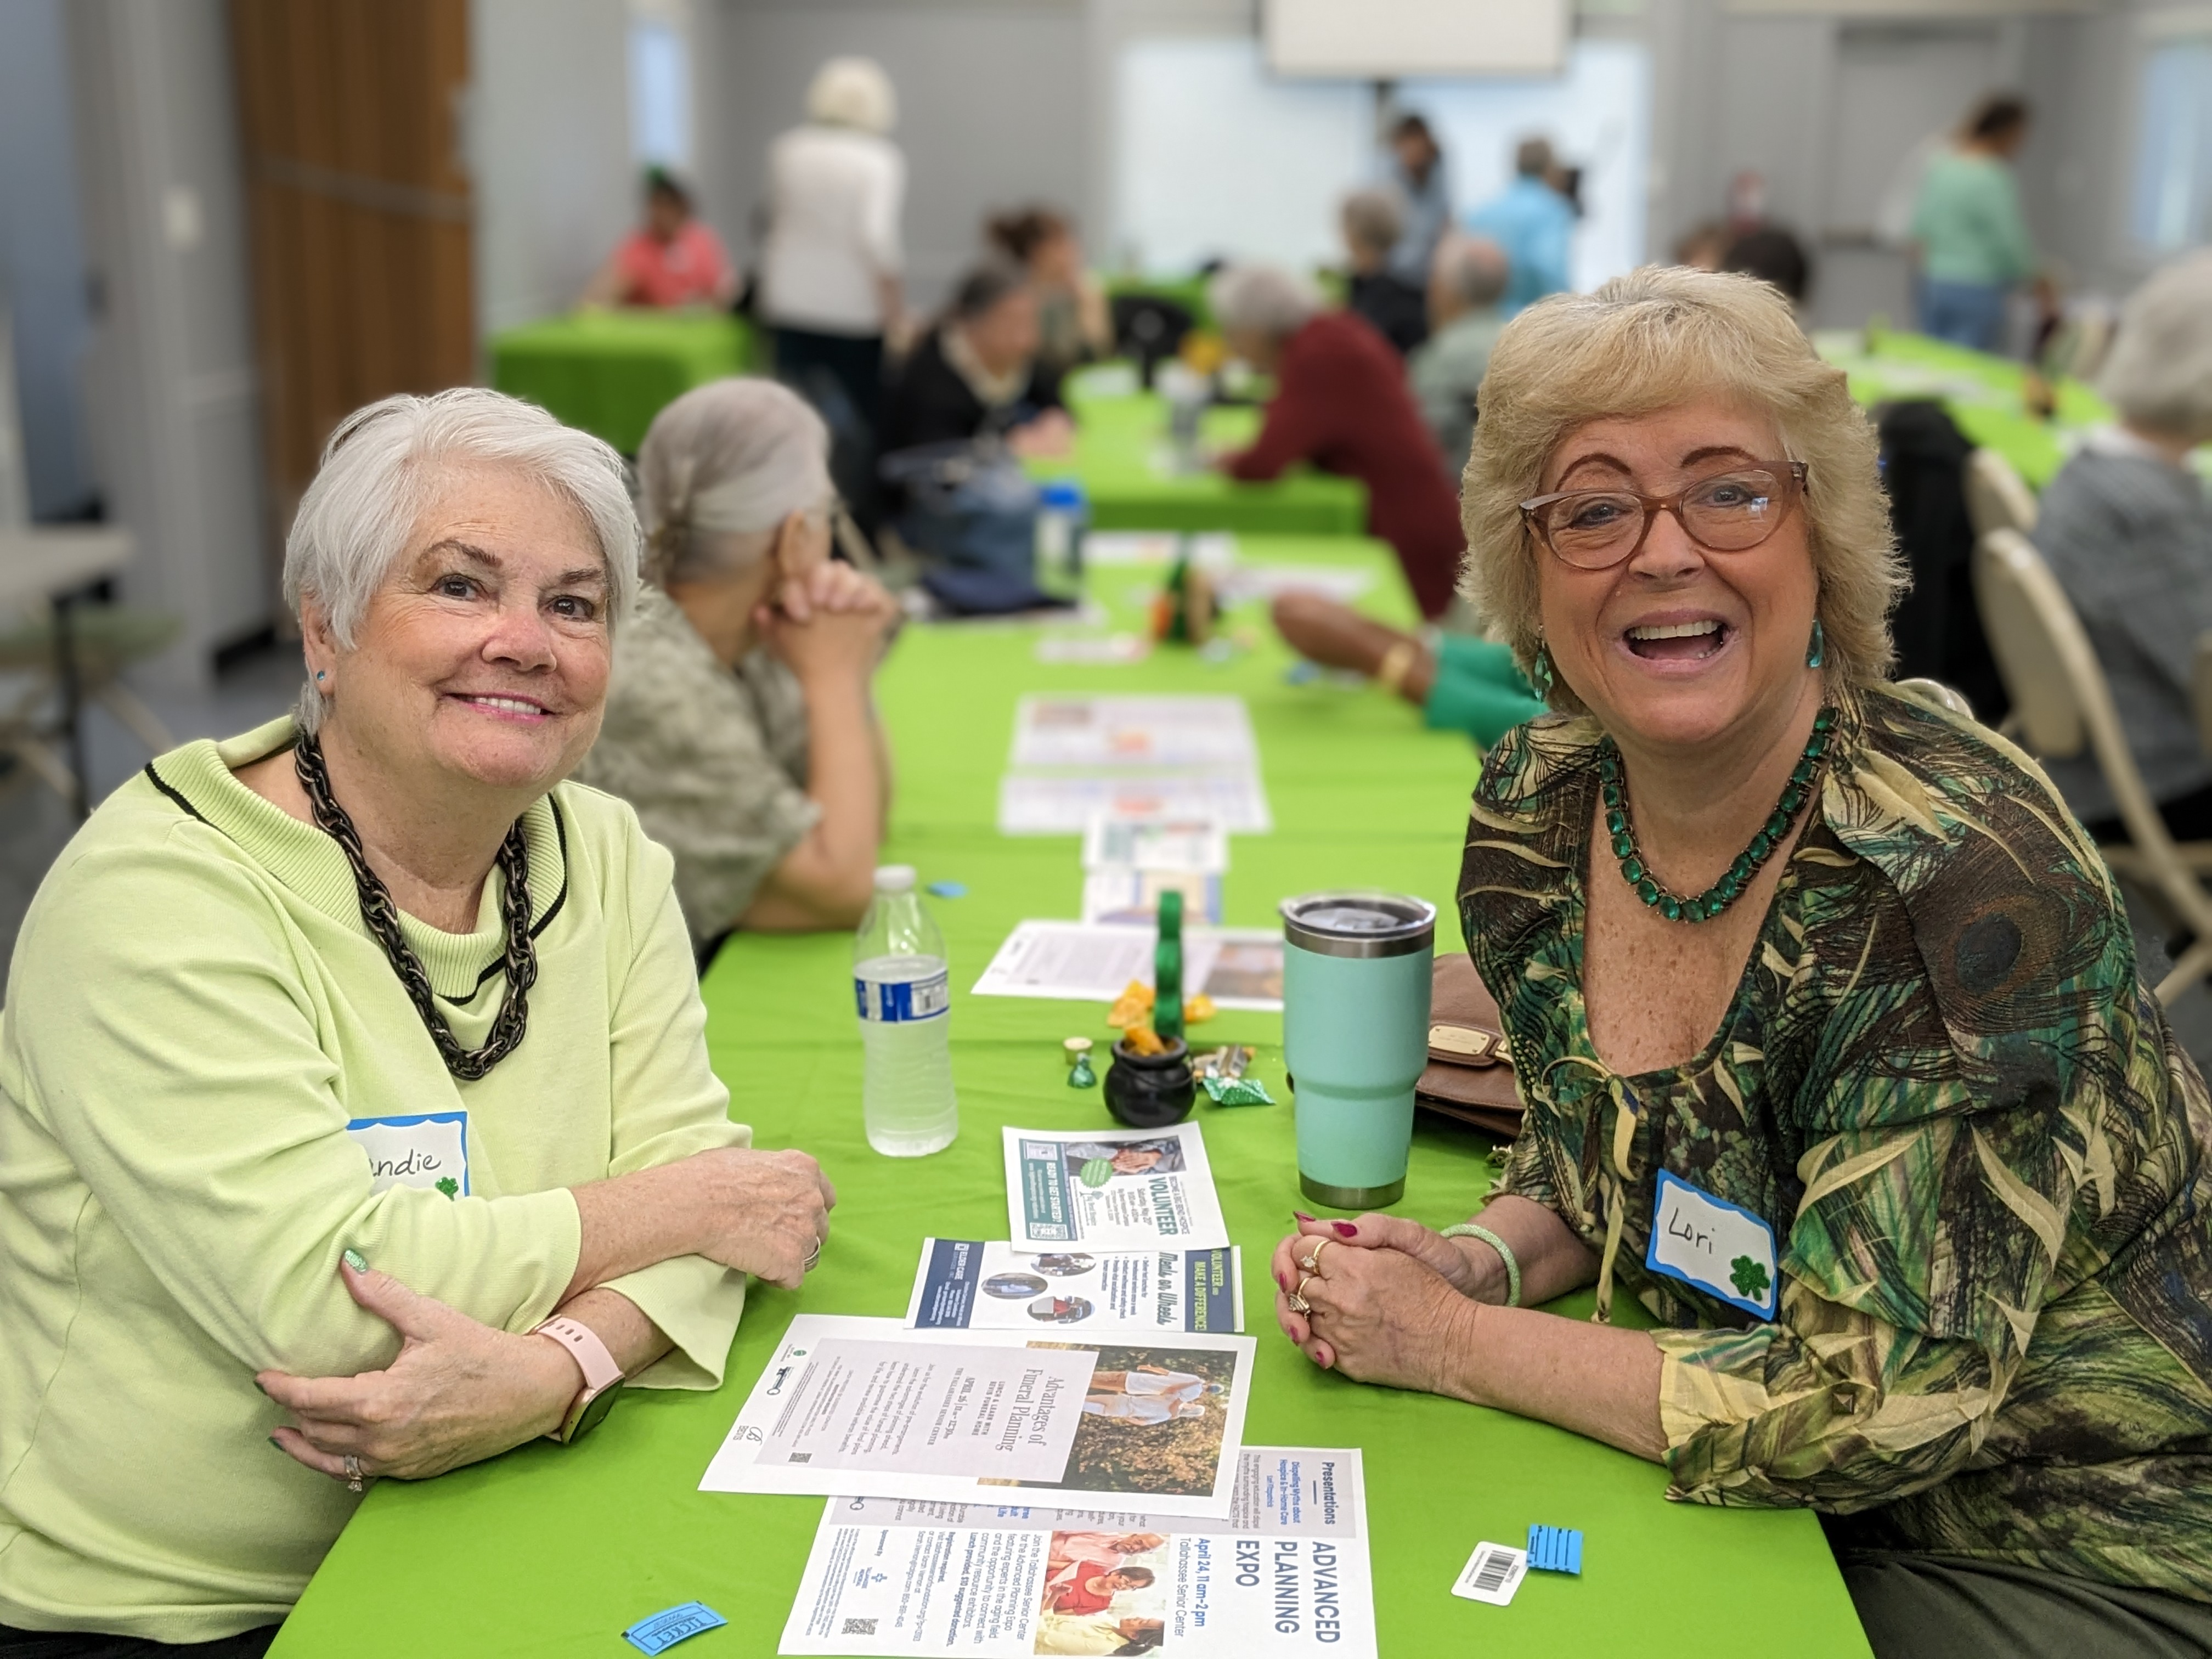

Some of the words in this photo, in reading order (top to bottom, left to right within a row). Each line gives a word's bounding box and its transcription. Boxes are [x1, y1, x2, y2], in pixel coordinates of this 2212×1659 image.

[369, 1148, 442, 1177] ndie
[1148, 1177, 1178, 1235] VOLUNTEER
[1669, 1206, 1715, 1255] Lori
[1158, 1252, 1177, 1278] Meals
[1194, 1261, 1206, 1282] MAKE
[1158, 1279, 1171, 1291] on
[1156, 1292, 1177, 1325] Wheels
[941, 1376, 960, 1407] TALLAHASSEE
[1014, 1369, 1043, 1403] Funeral
[977, 1397, 991, 1419] FUNERAL
[1027, 1376, 1066, 1432] Advantages
[934, 1409, 947, 1425] SENIOR
[926, 1426, 940, 1446] CENTER
[995, 1406, 1031, 1452] Planning
[1027, 1434, 1049, 1446] of
[1290, 1462, 1300, 1488] Dispelling
[1290, 1488, 1300, 1505] Myths
[1322, 1462, 1339, 1525] Presentations
[1280, 1511, 1289, 1526] Care
[1292, 1506, 1301, 1523] about
[923, 1537, 934, 1554] contact
[940, 1532, 955, 1560] Registration
[968, 1532, 978, 1548] Lunch
[972, 1533, 991, 1566] community
[993, 1533, 1003, 1544] and
[1001, 1533, 1017, 1560] featuring
[1018, 1543, 1028, 1553] the
[1032, 1534, 1042, 1546] Join
[1194, 1538, 1211, 1559] April
[919, 1555, 930, 1568] Sarah
[991, 1546, 1001, 1556] the
[1031, 1547, 1040, 1557] the
[1177, 1538, 1190, 1582] Tallahassee
[996, 1561, 1011, 1584] experts
[1012, 1555, 1026, 1585] Advanced
[1195, 1561, 1210, 1573] 24,
[1235, 1540, 1259, 1586] EXPO
[959, 1576, 969, 1585] $10
[969, 1568, 981, 1595] resource
[980, 1557, 999, 1593] opportunity
[1024, 1559, 1039, 1595] Tallahassee
[995, 1593, 1006, 1603] the
[1176, 1584, 1189, 1608] Senior
[1274, 1541, 1299, 1633] PLANNING
[1312, 1542, 1340, 1643] ADVANCED
[950, 1587, 967, 1617] suggested
[1004, 1587, 1020, 1615] Planning
[1020, 1598, 1032, 1617] Senior
[976, 1602, 989, 1628] connect
[988, 1605, 1003, 1623] aging
[1001, 1616, 1015, 1630] Expo
[1173, 1610, 1187, 1637] Center
[1190, 1611, 1205, 1626] pm
[656, 1617, 707, 1646] TICKET
[945, 1618, 960, 1646] donation.
[973, 1630, 985, 1644] with
[988, 1624, 1000, 1638] field
[1016, 1618, 1029, 1640] Center
